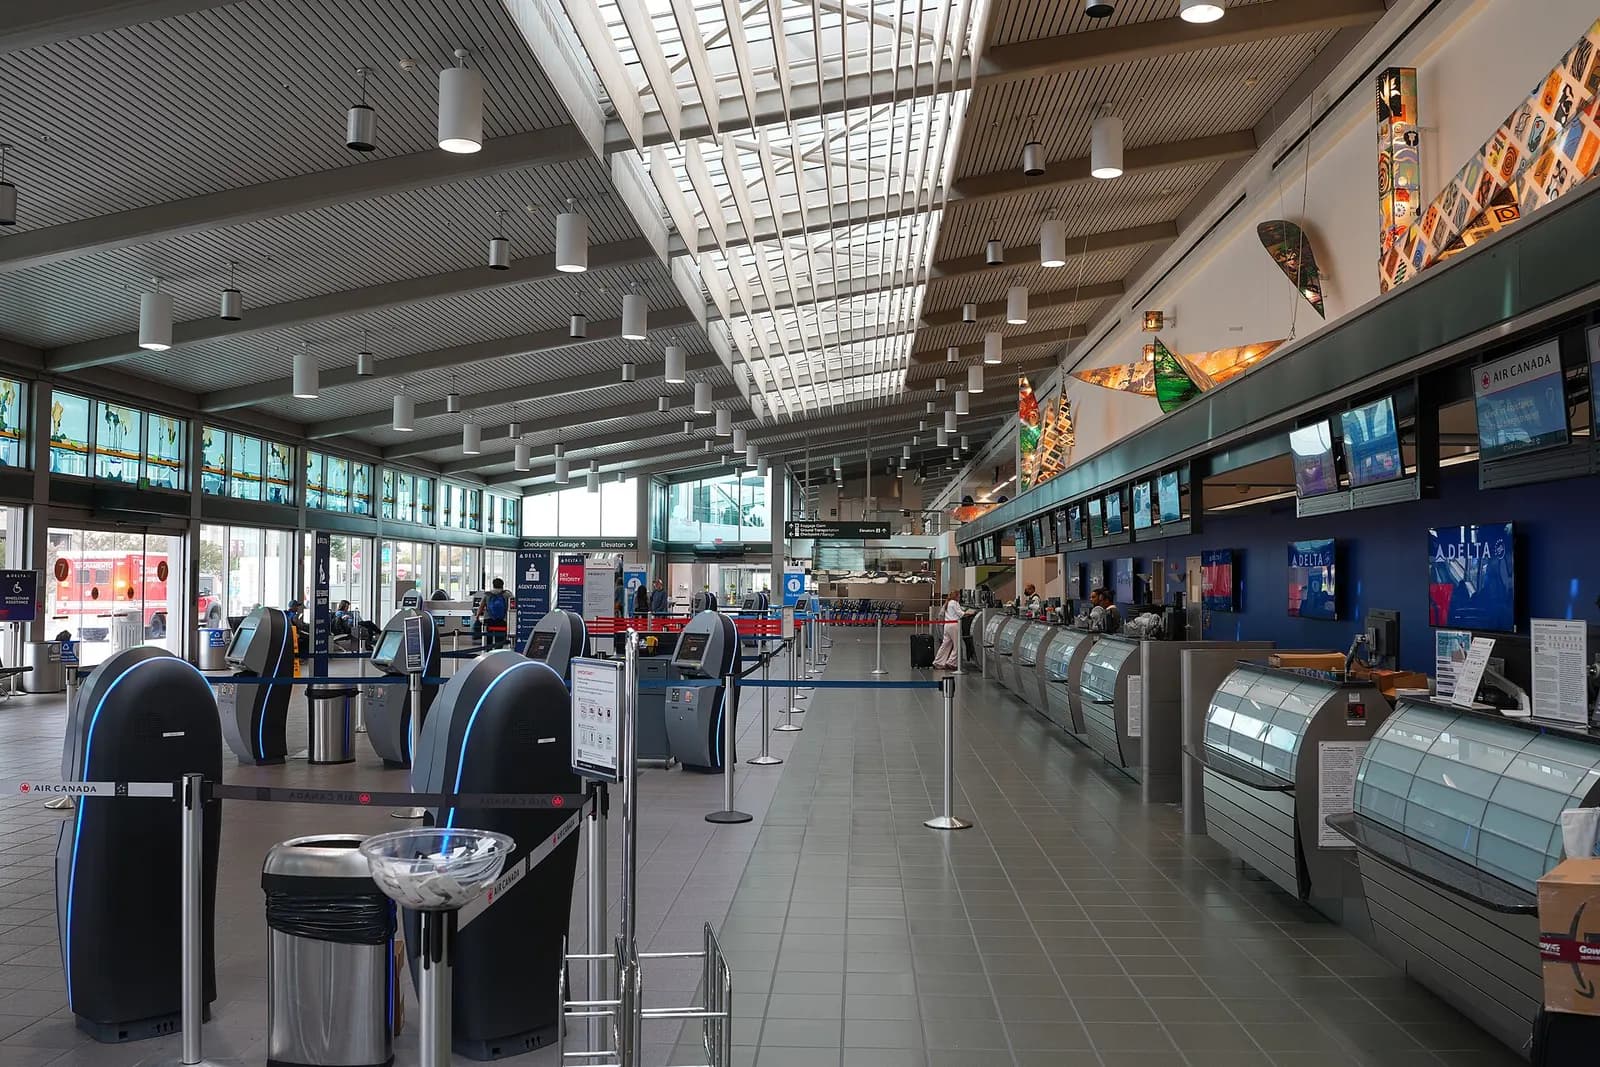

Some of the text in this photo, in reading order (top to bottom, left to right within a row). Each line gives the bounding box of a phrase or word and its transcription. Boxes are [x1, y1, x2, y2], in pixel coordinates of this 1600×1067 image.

[1493, 354, 1552, 382] AIR CANADA
[523, 541, 555, 549] Checkpoint
[1449, 542, 1490, 559] DELTA
[1299, 553, 1324, 566] DELTA
[60, 563, 65, 577] 7
[161, 565, 165, 576] 7
[792, 581, 796, 590] 1
[34, 784, 97, 793] AIR CANADA
[562, 818, 575, 835] CANADA
[494, 868, 520, 896] AIR CANADA
